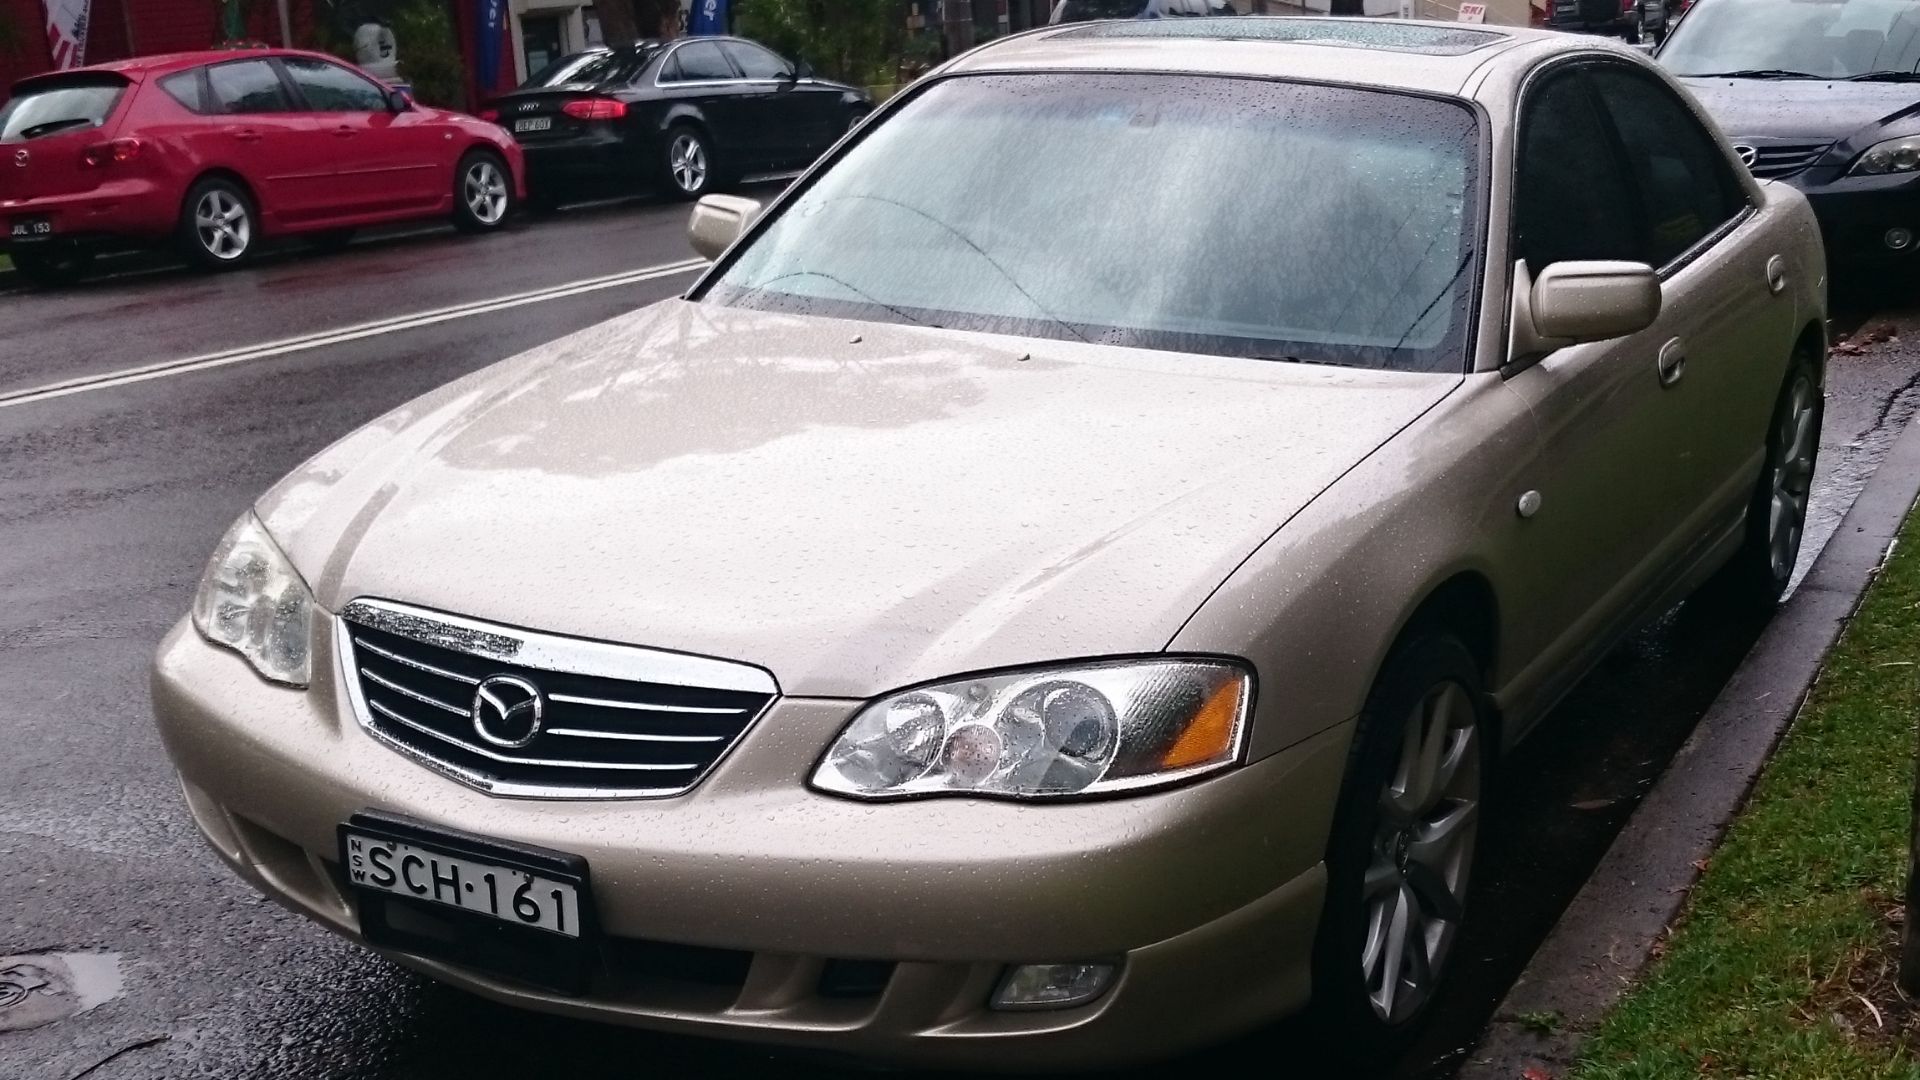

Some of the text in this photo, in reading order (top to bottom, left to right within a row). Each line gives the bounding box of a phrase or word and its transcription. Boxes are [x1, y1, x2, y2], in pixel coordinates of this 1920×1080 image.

[1461, 5, 1483, 16] SKI
[11, 222, 50, 235] JUL 153
